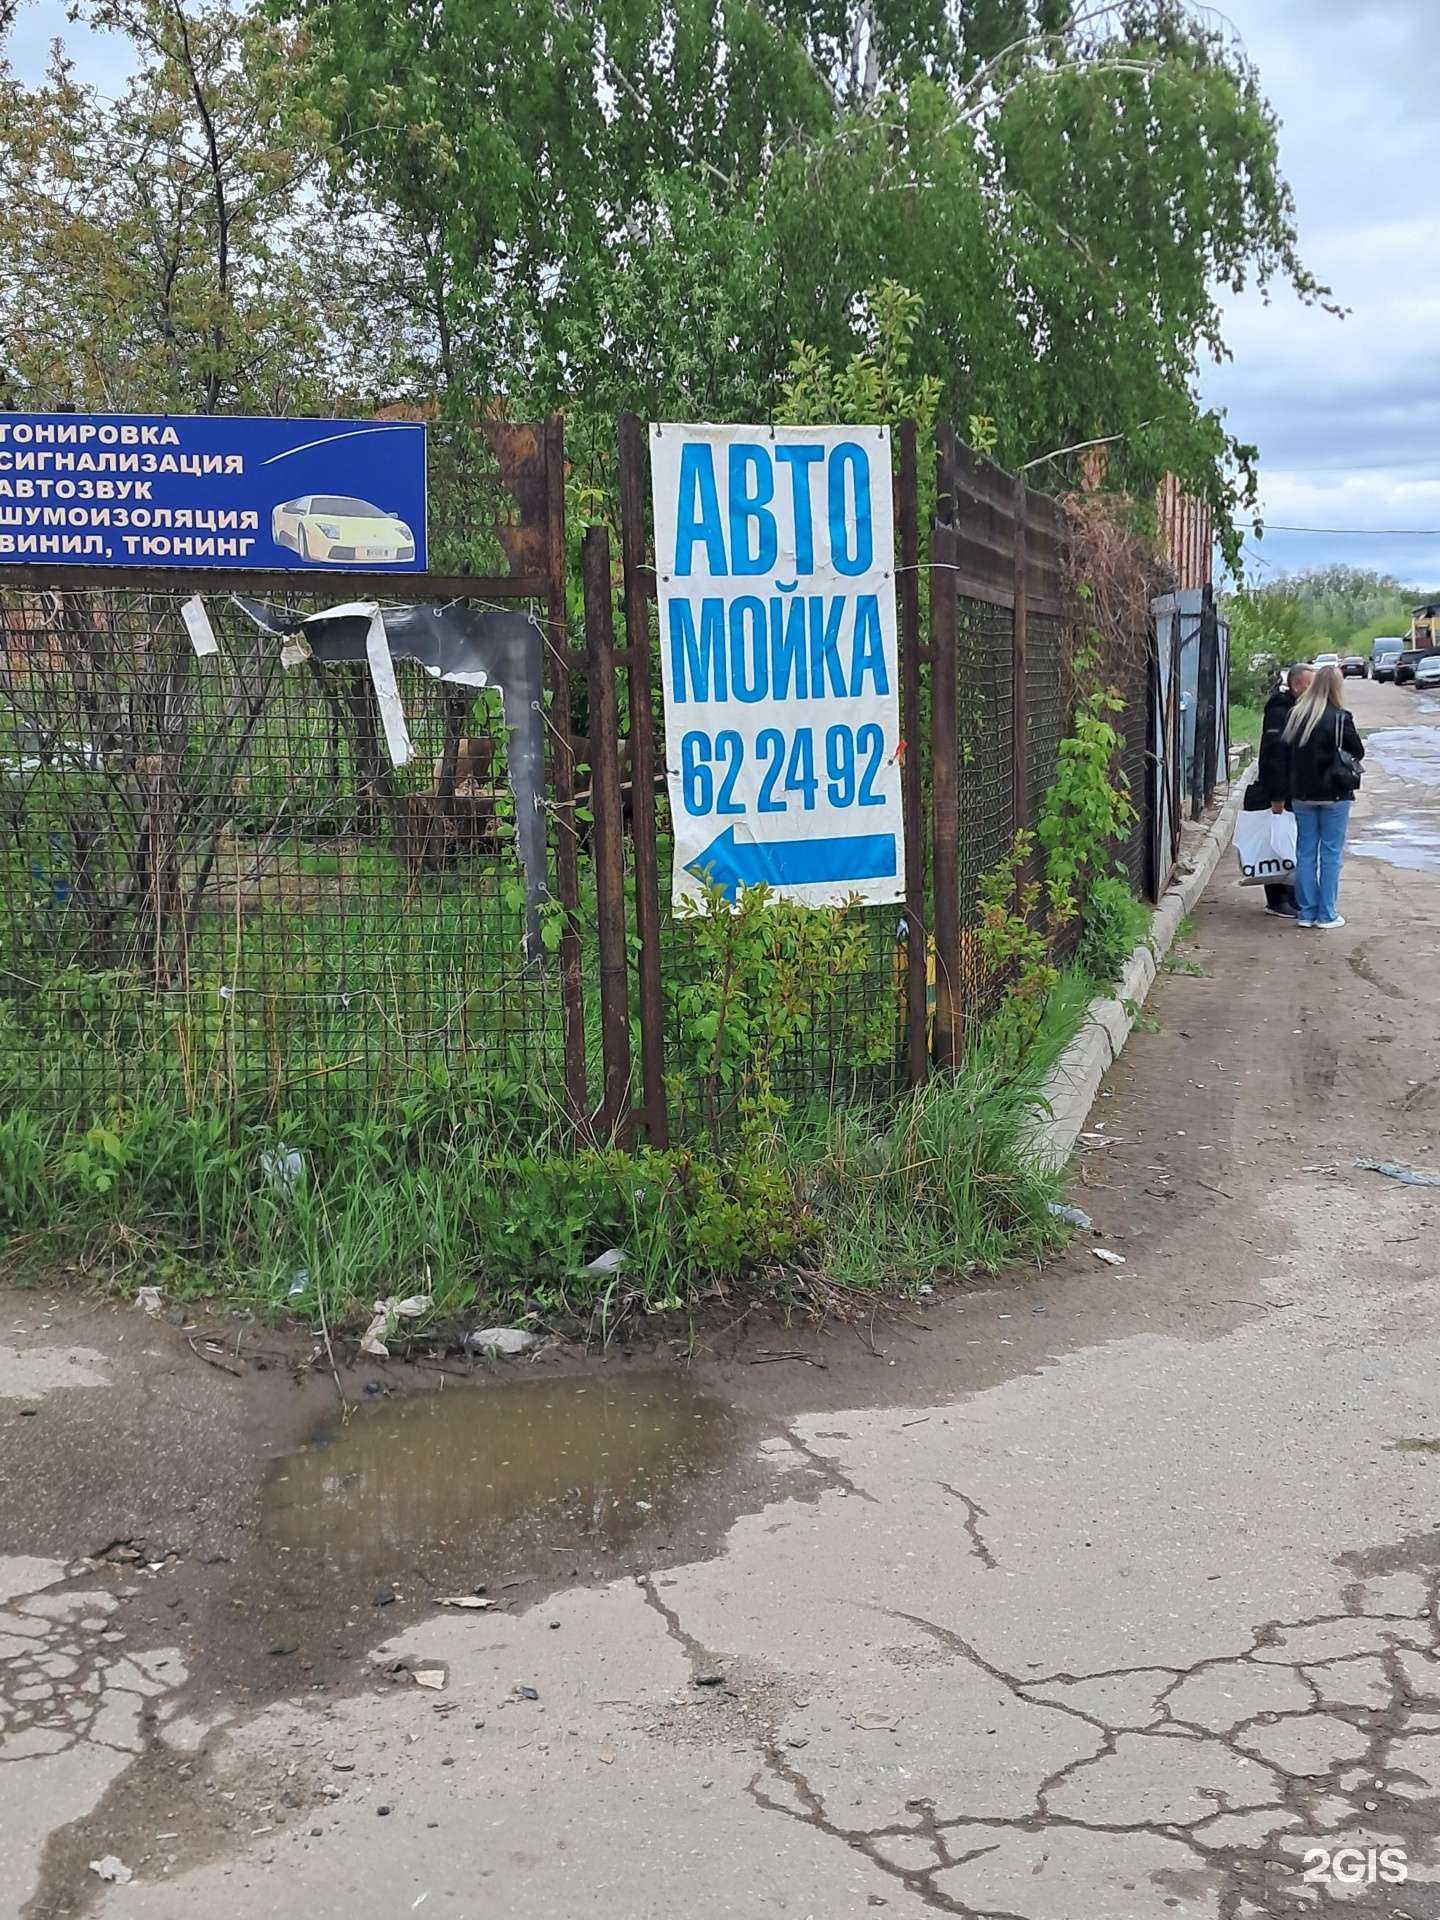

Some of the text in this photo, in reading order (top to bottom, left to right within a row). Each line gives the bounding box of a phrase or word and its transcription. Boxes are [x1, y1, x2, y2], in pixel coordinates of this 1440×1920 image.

[0, 424, 179, 444] ТОНИРОВКА
[0, 452, 243, 477] СИГНАЛИЗАЦИЯ
[0, 480, 152, 499] АВТОЗВУК
[0, 507, 258, 532] ШУМОИЗОЛЯЦИЯ
[674, 443, 873, 577] АВТО
[0, 535, 255, 558] ВИНИЛ, ТЮНИНГ
[668, 579, 889, 704] МОЙКА
